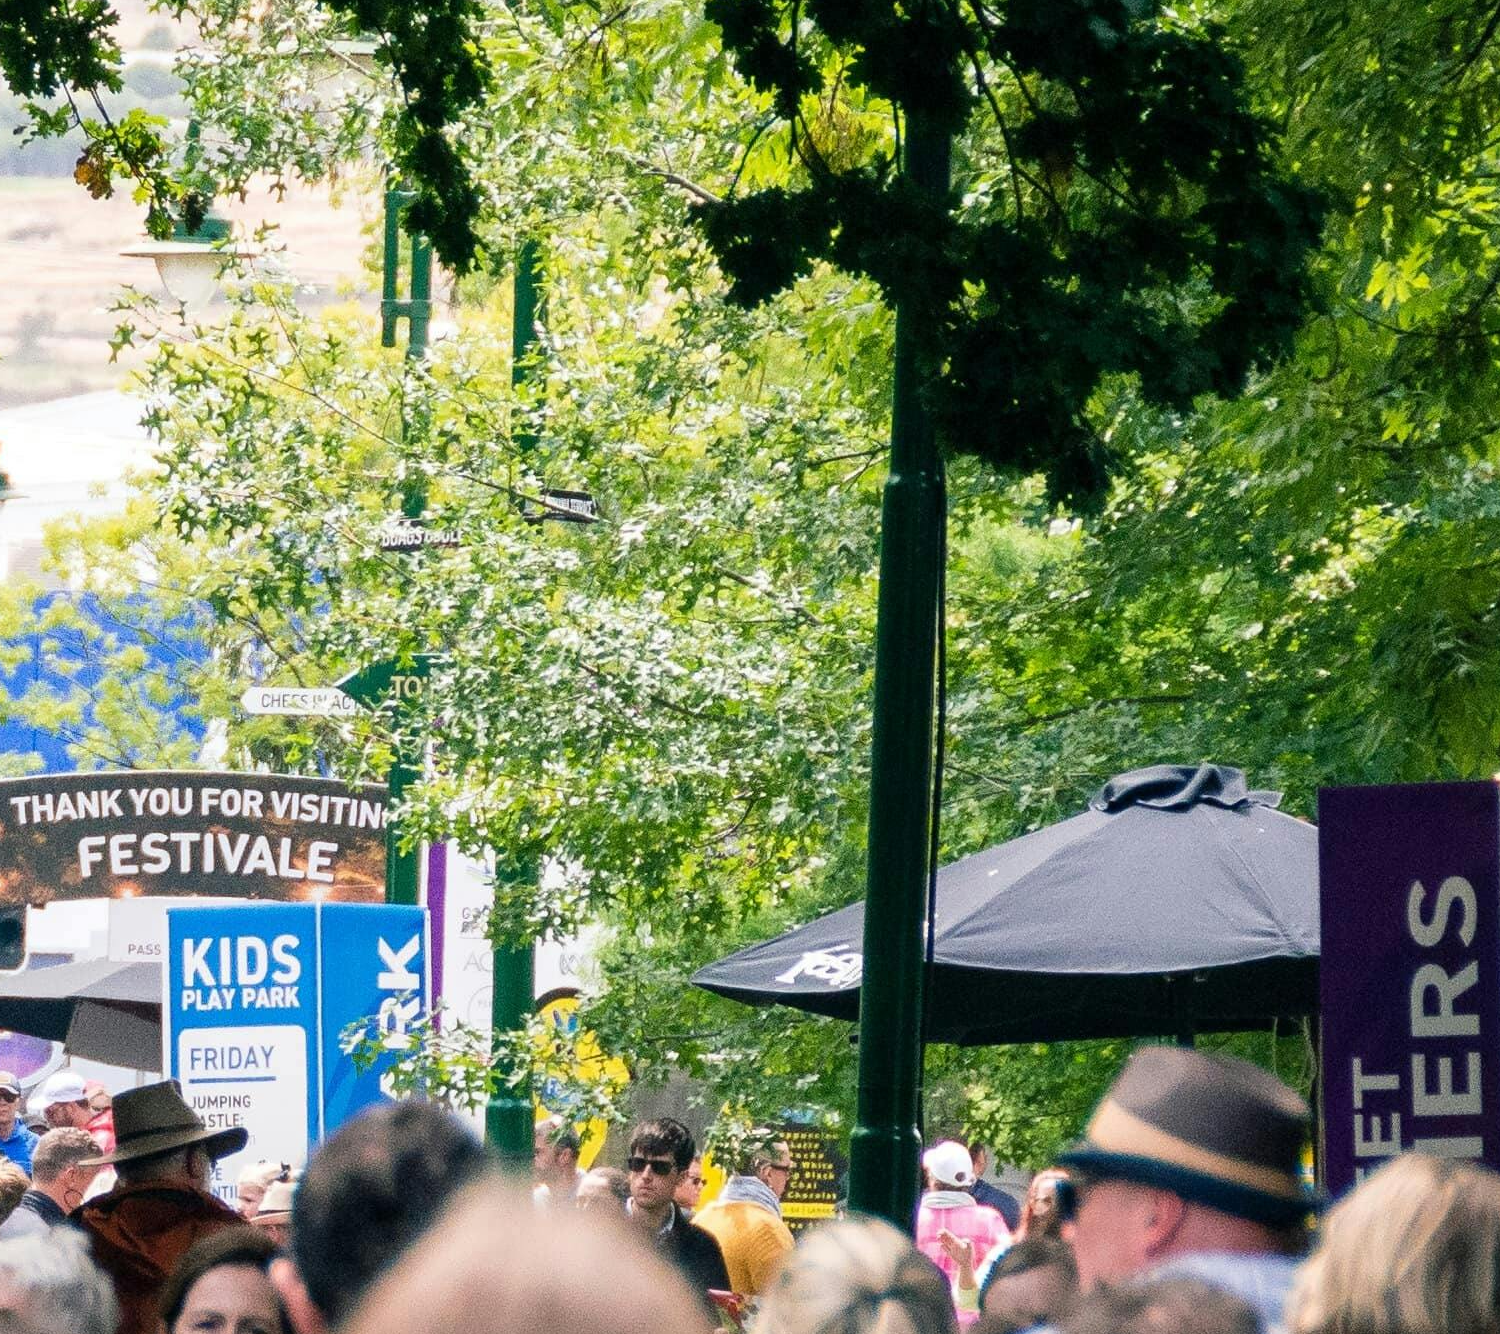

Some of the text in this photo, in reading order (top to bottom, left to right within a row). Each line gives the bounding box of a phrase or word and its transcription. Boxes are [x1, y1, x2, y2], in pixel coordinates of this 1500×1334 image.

[10, 786, 387, 830] THANK YOU FOR VISITIN
[77, 831, 340, 884] FESTIVALE
[182, 933, 302, 988] KIDS
[181, 985, 301, 1012] PLAY PARK
[189, 1045, 275, 1071] FRIDAY
[191, 1094, 252, 1109] JUMPING
[1352, 1056, 1401, 1157] ET
[200, 1113, 244, 1129] ASTLE:
